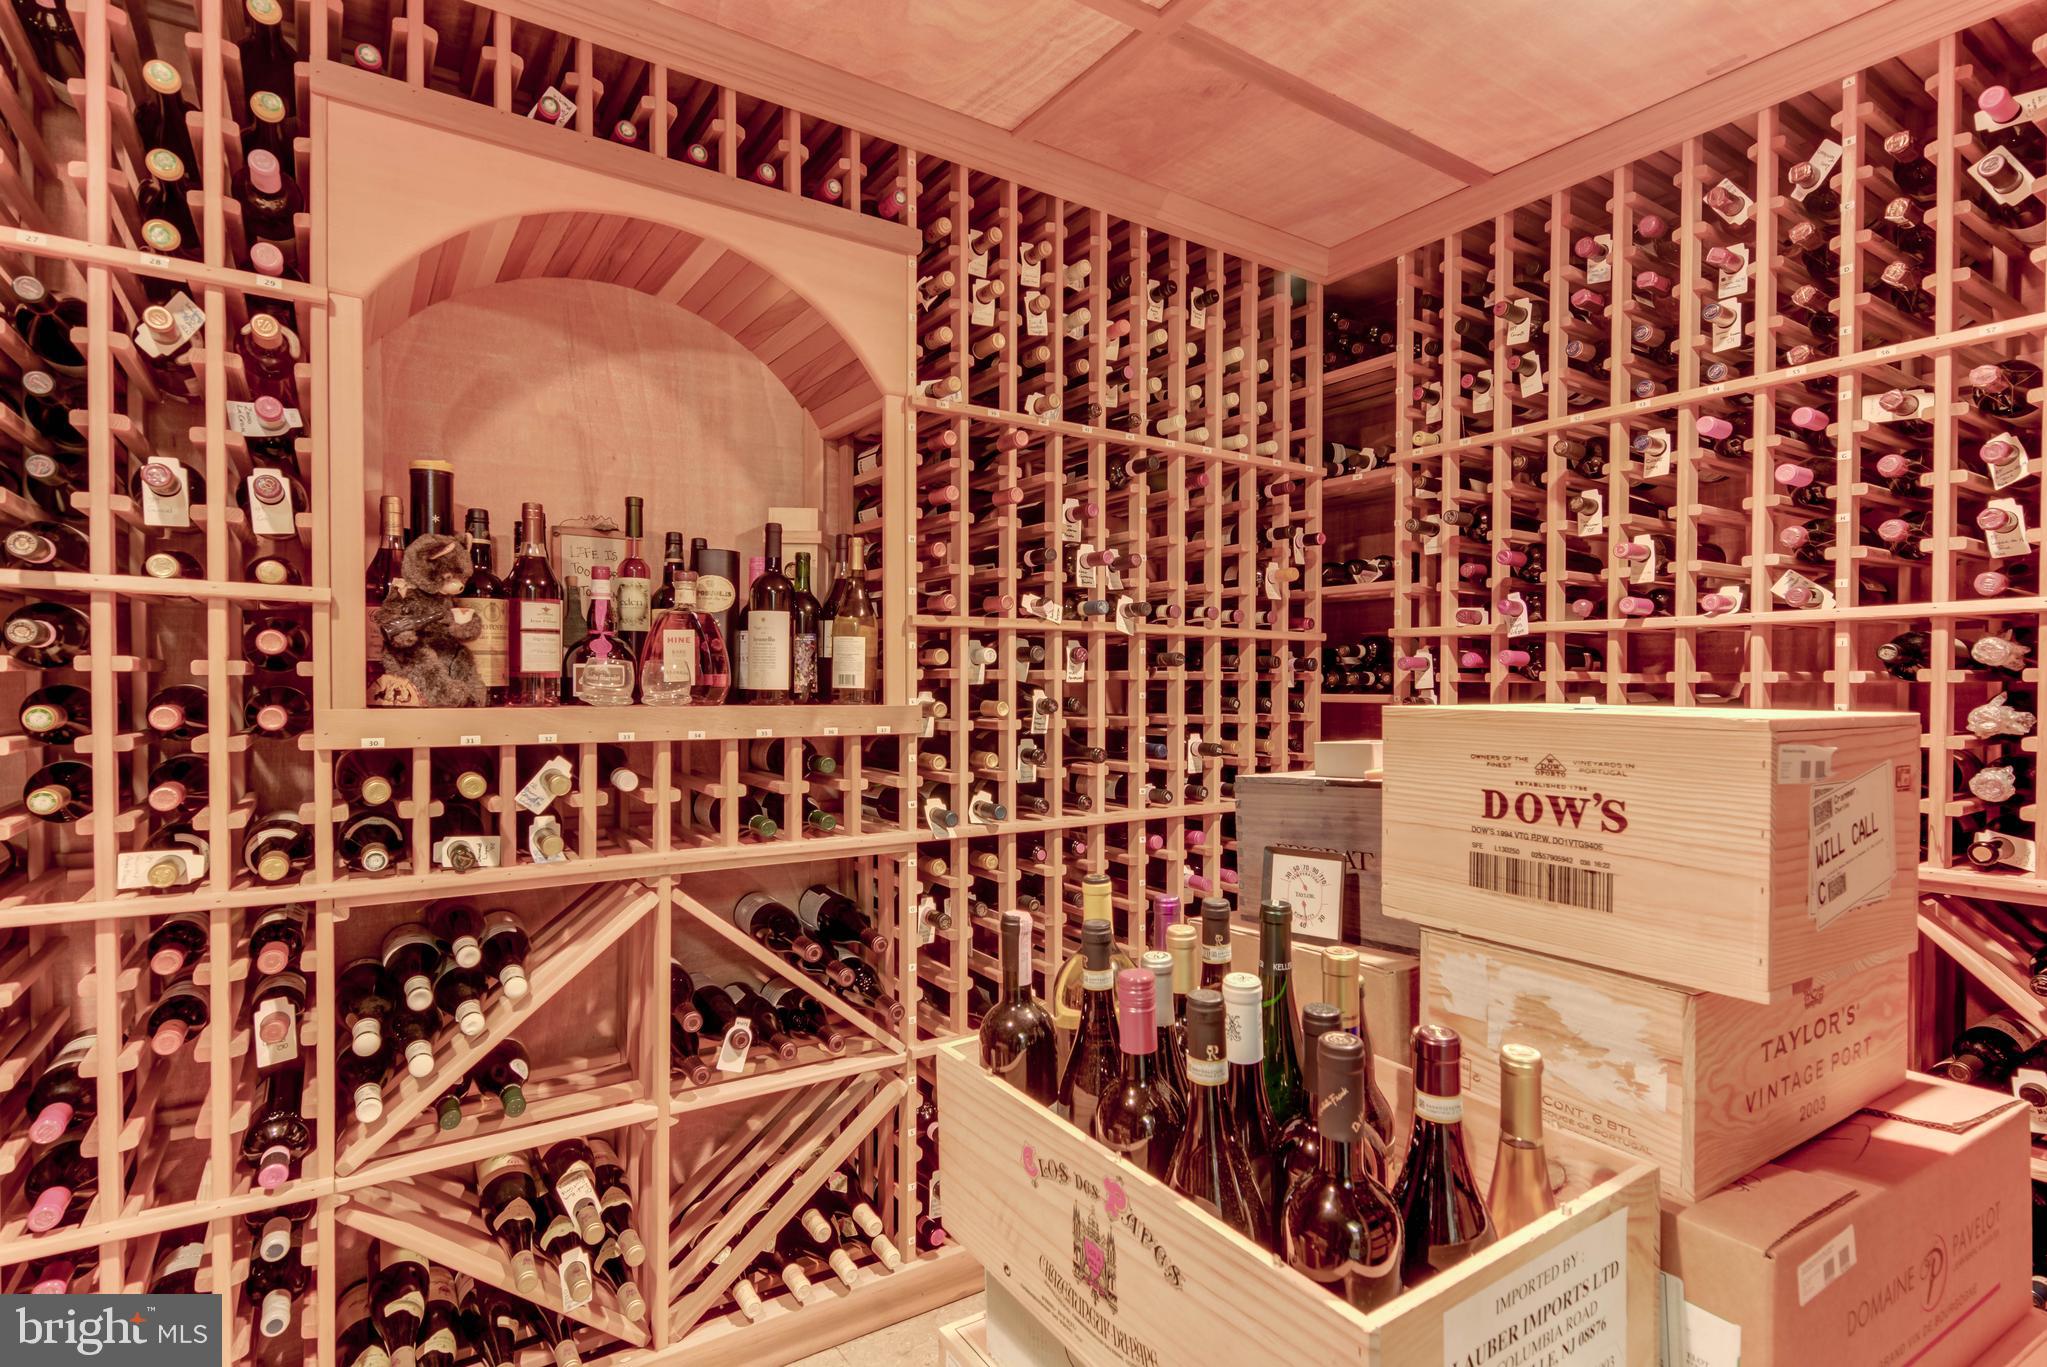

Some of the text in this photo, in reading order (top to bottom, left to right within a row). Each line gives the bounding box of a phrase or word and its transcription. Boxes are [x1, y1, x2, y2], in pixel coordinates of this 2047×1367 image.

[264, 279, 276, 287] 29
[1470, 753, 1500, 761] OWNERS
[1572, 760, 1623, 769] VINEYARDS
[1578, 768, 1629, 777] PORTUGAL
[1514, 780, 1567, 790] ESTABLISHED
[1481, 788, 1629, 834] DOW'S
[1815, 832, 1845, 869] WILL
[1852, 811, 1878, 846] CALL
[1760, 1004, 1856, 1063] TAYLOR'S
[1745, 1036, 1872, 1113] VINTAGE PORT
[1799, 1095, 1826, 1122] 2003
[1592, 1113, 1603, 1125] 6
[1607, 1120, 1637, 1139] BTL
[1593, 1128, 1653, 1156] PORTUGAL
[1952, 1200, 2000, 1256] PAVELOT
[1495, 1264, 1560, 1315] IMPORTED
[1523, 1277, 1590, 1336] IMPORTS
[1593, 1259, 1620, 1293] LTD
[1847, 1265, 1915, 1336] DOMAINE
[1566, 1300, 1598, 1331] ROAD
